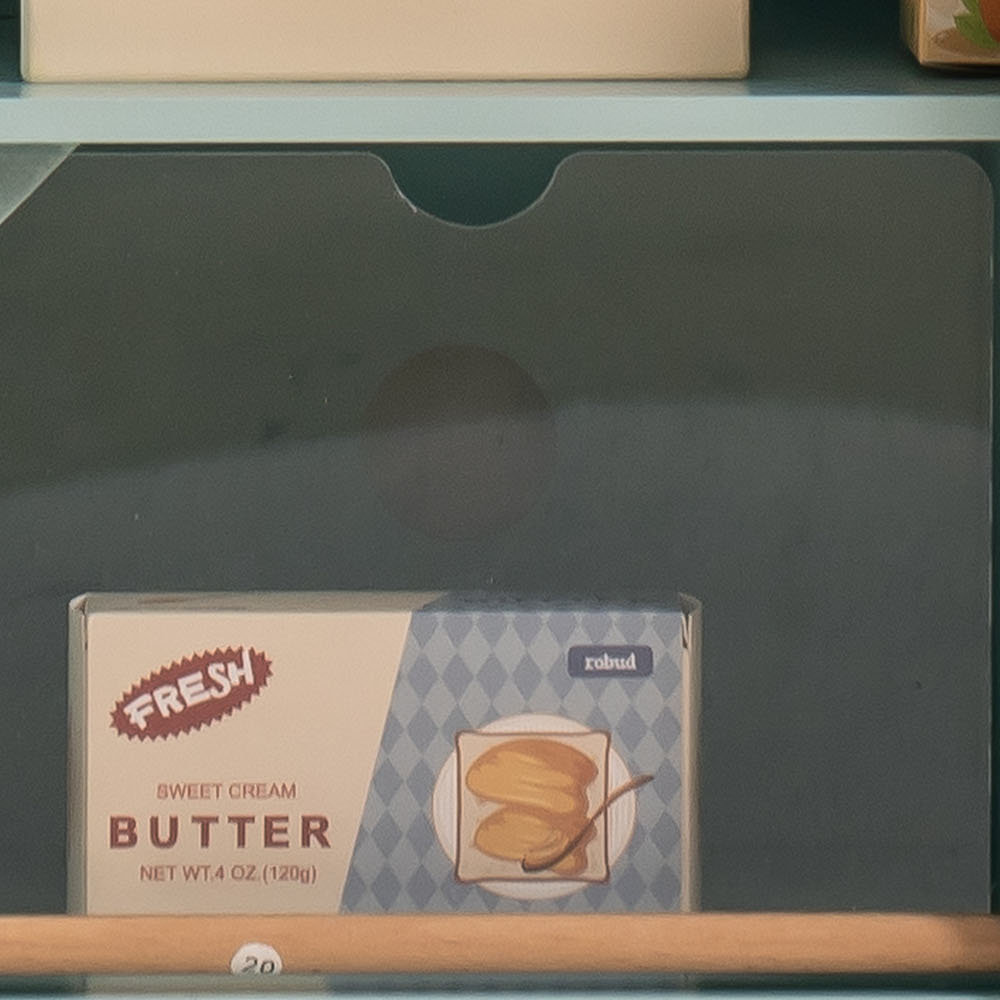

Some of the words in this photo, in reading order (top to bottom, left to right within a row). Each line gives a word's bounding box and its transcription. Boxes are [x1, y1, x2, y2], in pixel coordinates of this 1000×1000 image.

[583, 651, 637, 672] robud
[123, 649, 255, 731] FRESH
[156, 783, 223, 800] SWEET
[228, 783, 297, 800] CREAM
[109, 815, 331, 849] BUTTER
[140, 865, 177, 881] NET
